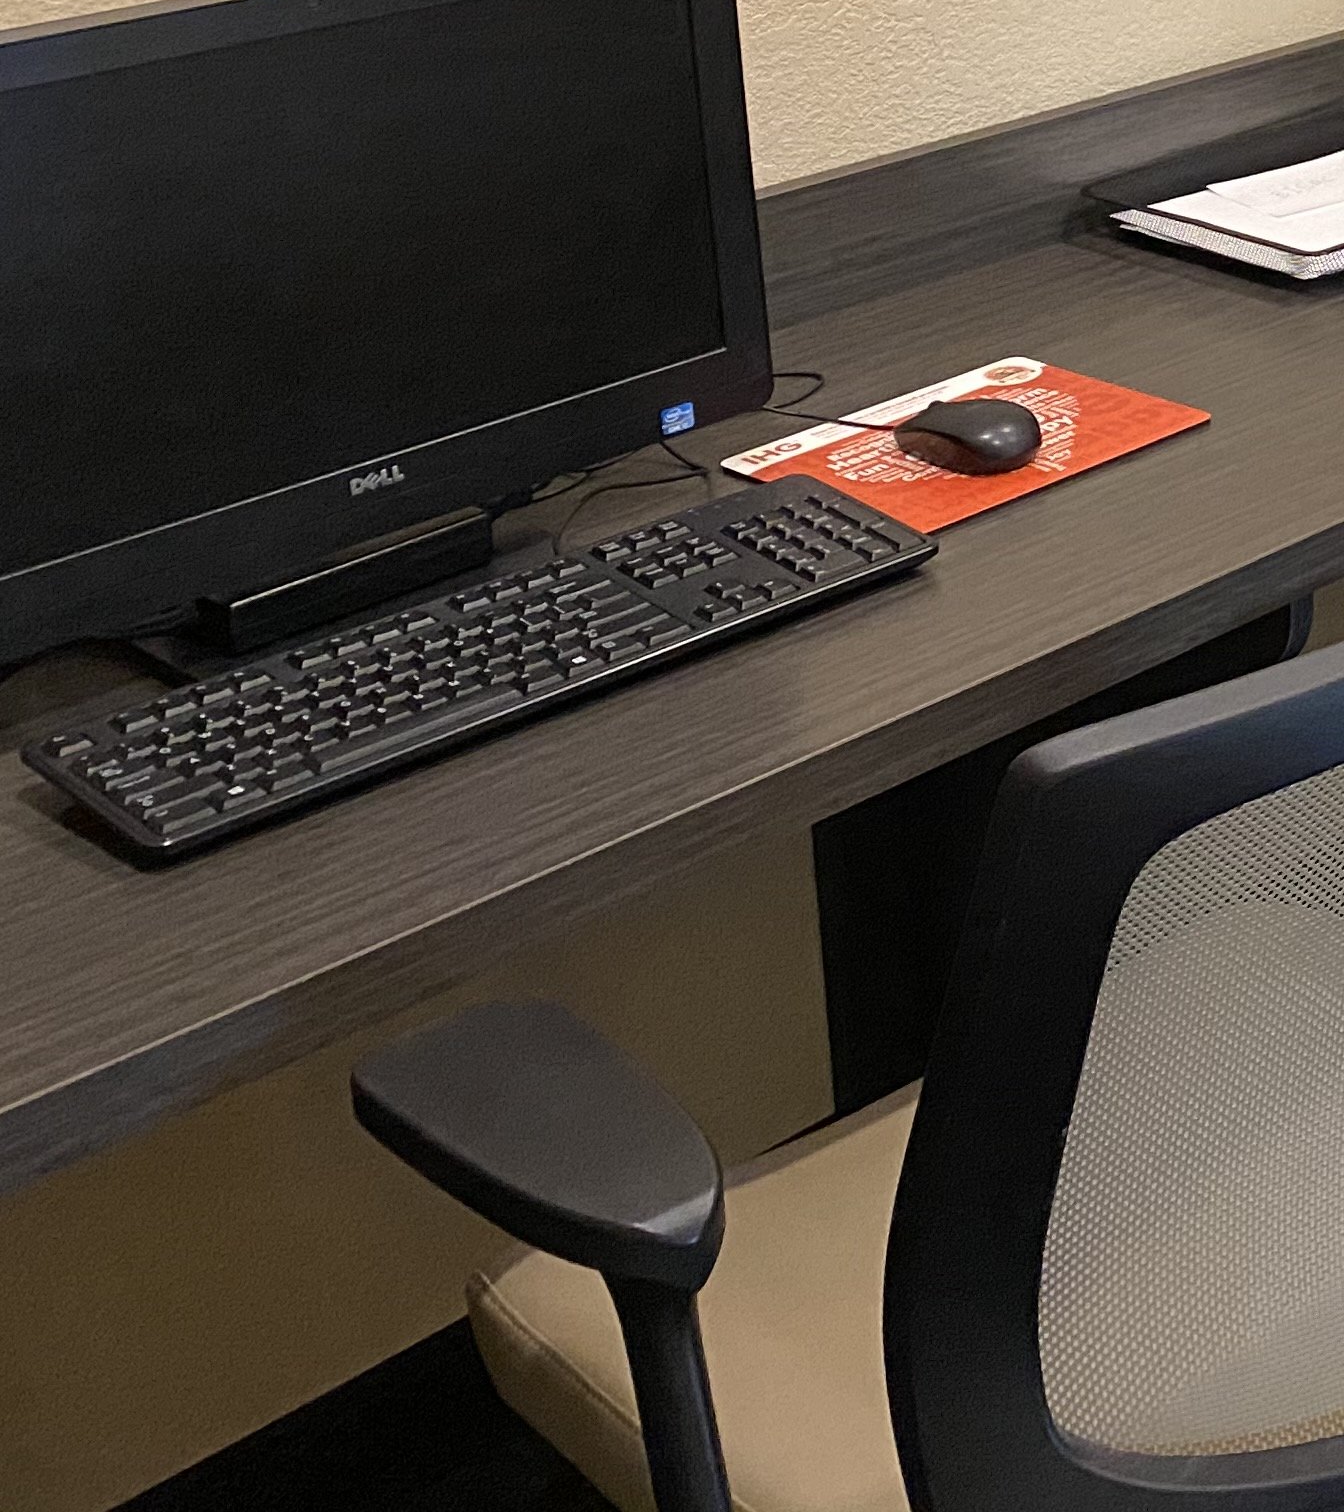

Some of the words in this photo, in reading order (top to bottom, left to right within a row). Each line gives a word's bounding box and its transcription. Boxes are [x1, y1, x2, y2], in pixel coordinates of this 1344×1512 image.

[741, 441, 803, 465] IHG
[350, 465, 405, 496] DELL
[842, 463, 890, 481] Fun
